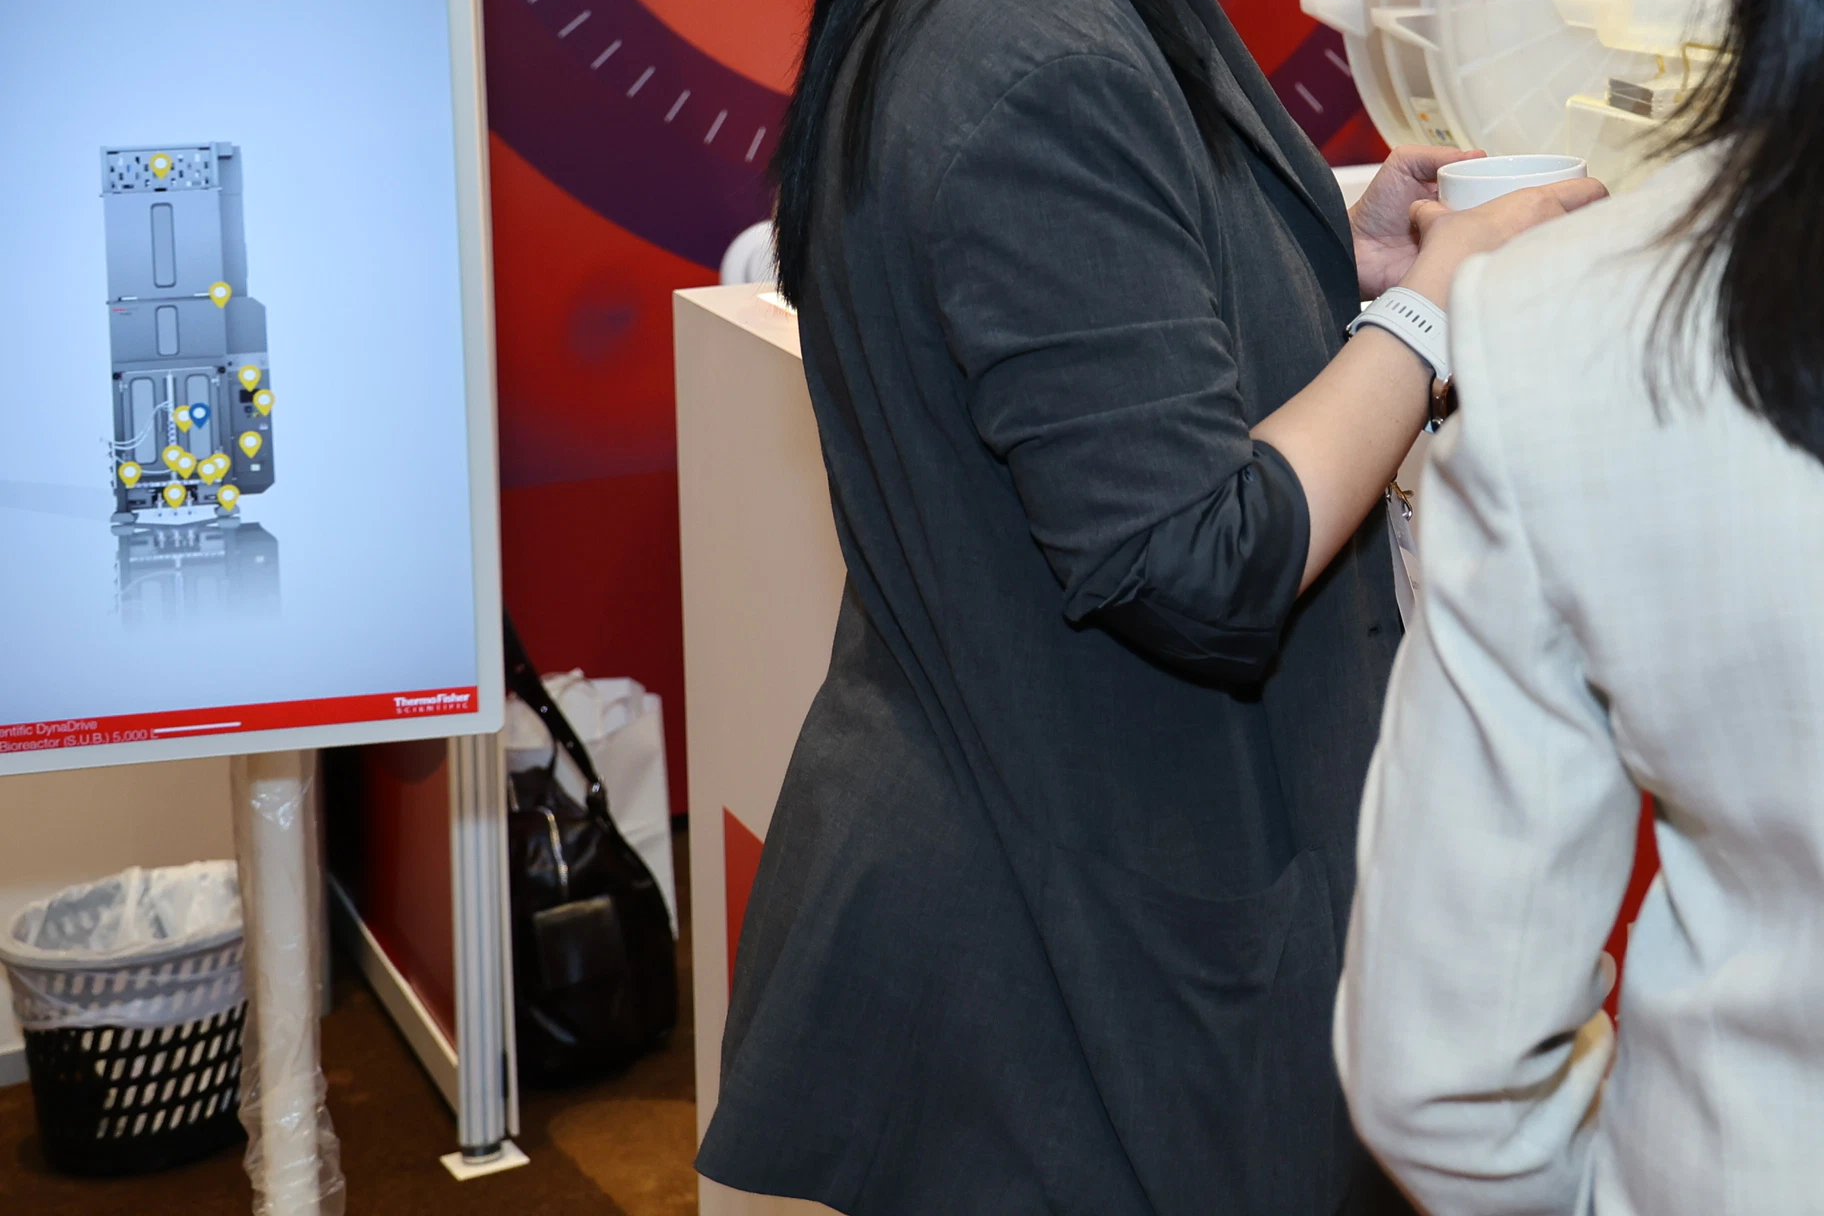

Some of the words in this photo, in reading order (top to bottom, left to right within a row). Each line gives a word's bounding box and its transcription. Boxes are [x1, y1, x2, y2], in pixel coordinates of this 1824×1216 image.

[36, 720, 98, 736] DynaDrive
[0, 738, 60, 752] Bioreactor
[112, 729, 147, 743] 5,000
